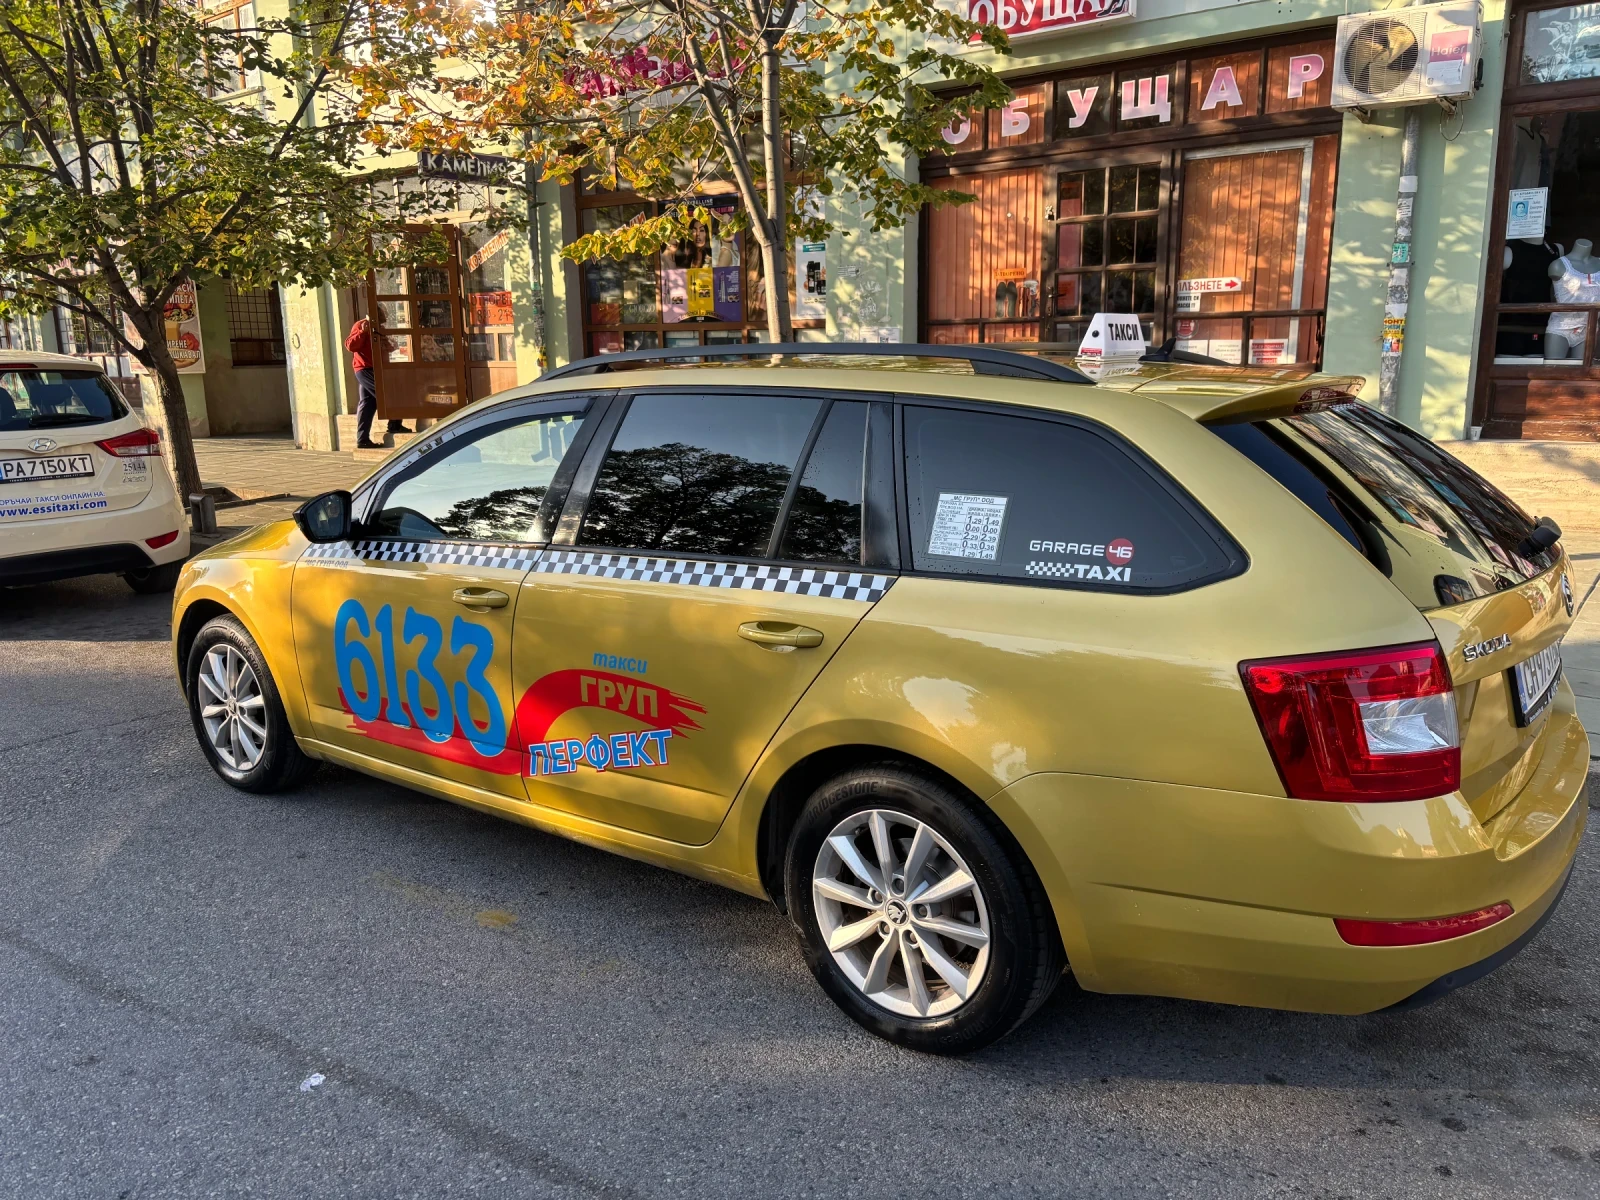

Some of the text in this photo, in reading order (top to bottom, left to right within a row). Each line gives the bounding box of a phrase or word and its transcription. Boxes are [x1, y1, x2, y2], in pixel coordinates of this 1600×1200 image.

[1431, 45, 1465, 56] Haier
[1108, 323, 1140, 341] ТАКСИ
[166, 340, 188, 348] ИРЕНЕ
[35, 495, 60, 503] ТАКСИ
[61, 491, 93, 501] ОНЛАЙН
[982, 525, 998, 534] 0.00
[985, 516, 1000, 526] 1.49
[963, 532, 979, 540] 2.29
[1029, 540, 1132, 558] GARAGE 46
[1074, 564, 1131, 581] TAXI
[1463, 633, 1512, 663] ŠKODA
[592, 651, 648, 674] такси
[334, 598, 507, 757] 6133
[579, 675, 658, 718] ГРУП
[529, 729, 673, 777] ПЕРФЕКТ
[806, 781, 879, 825] BRIDGESTONE
